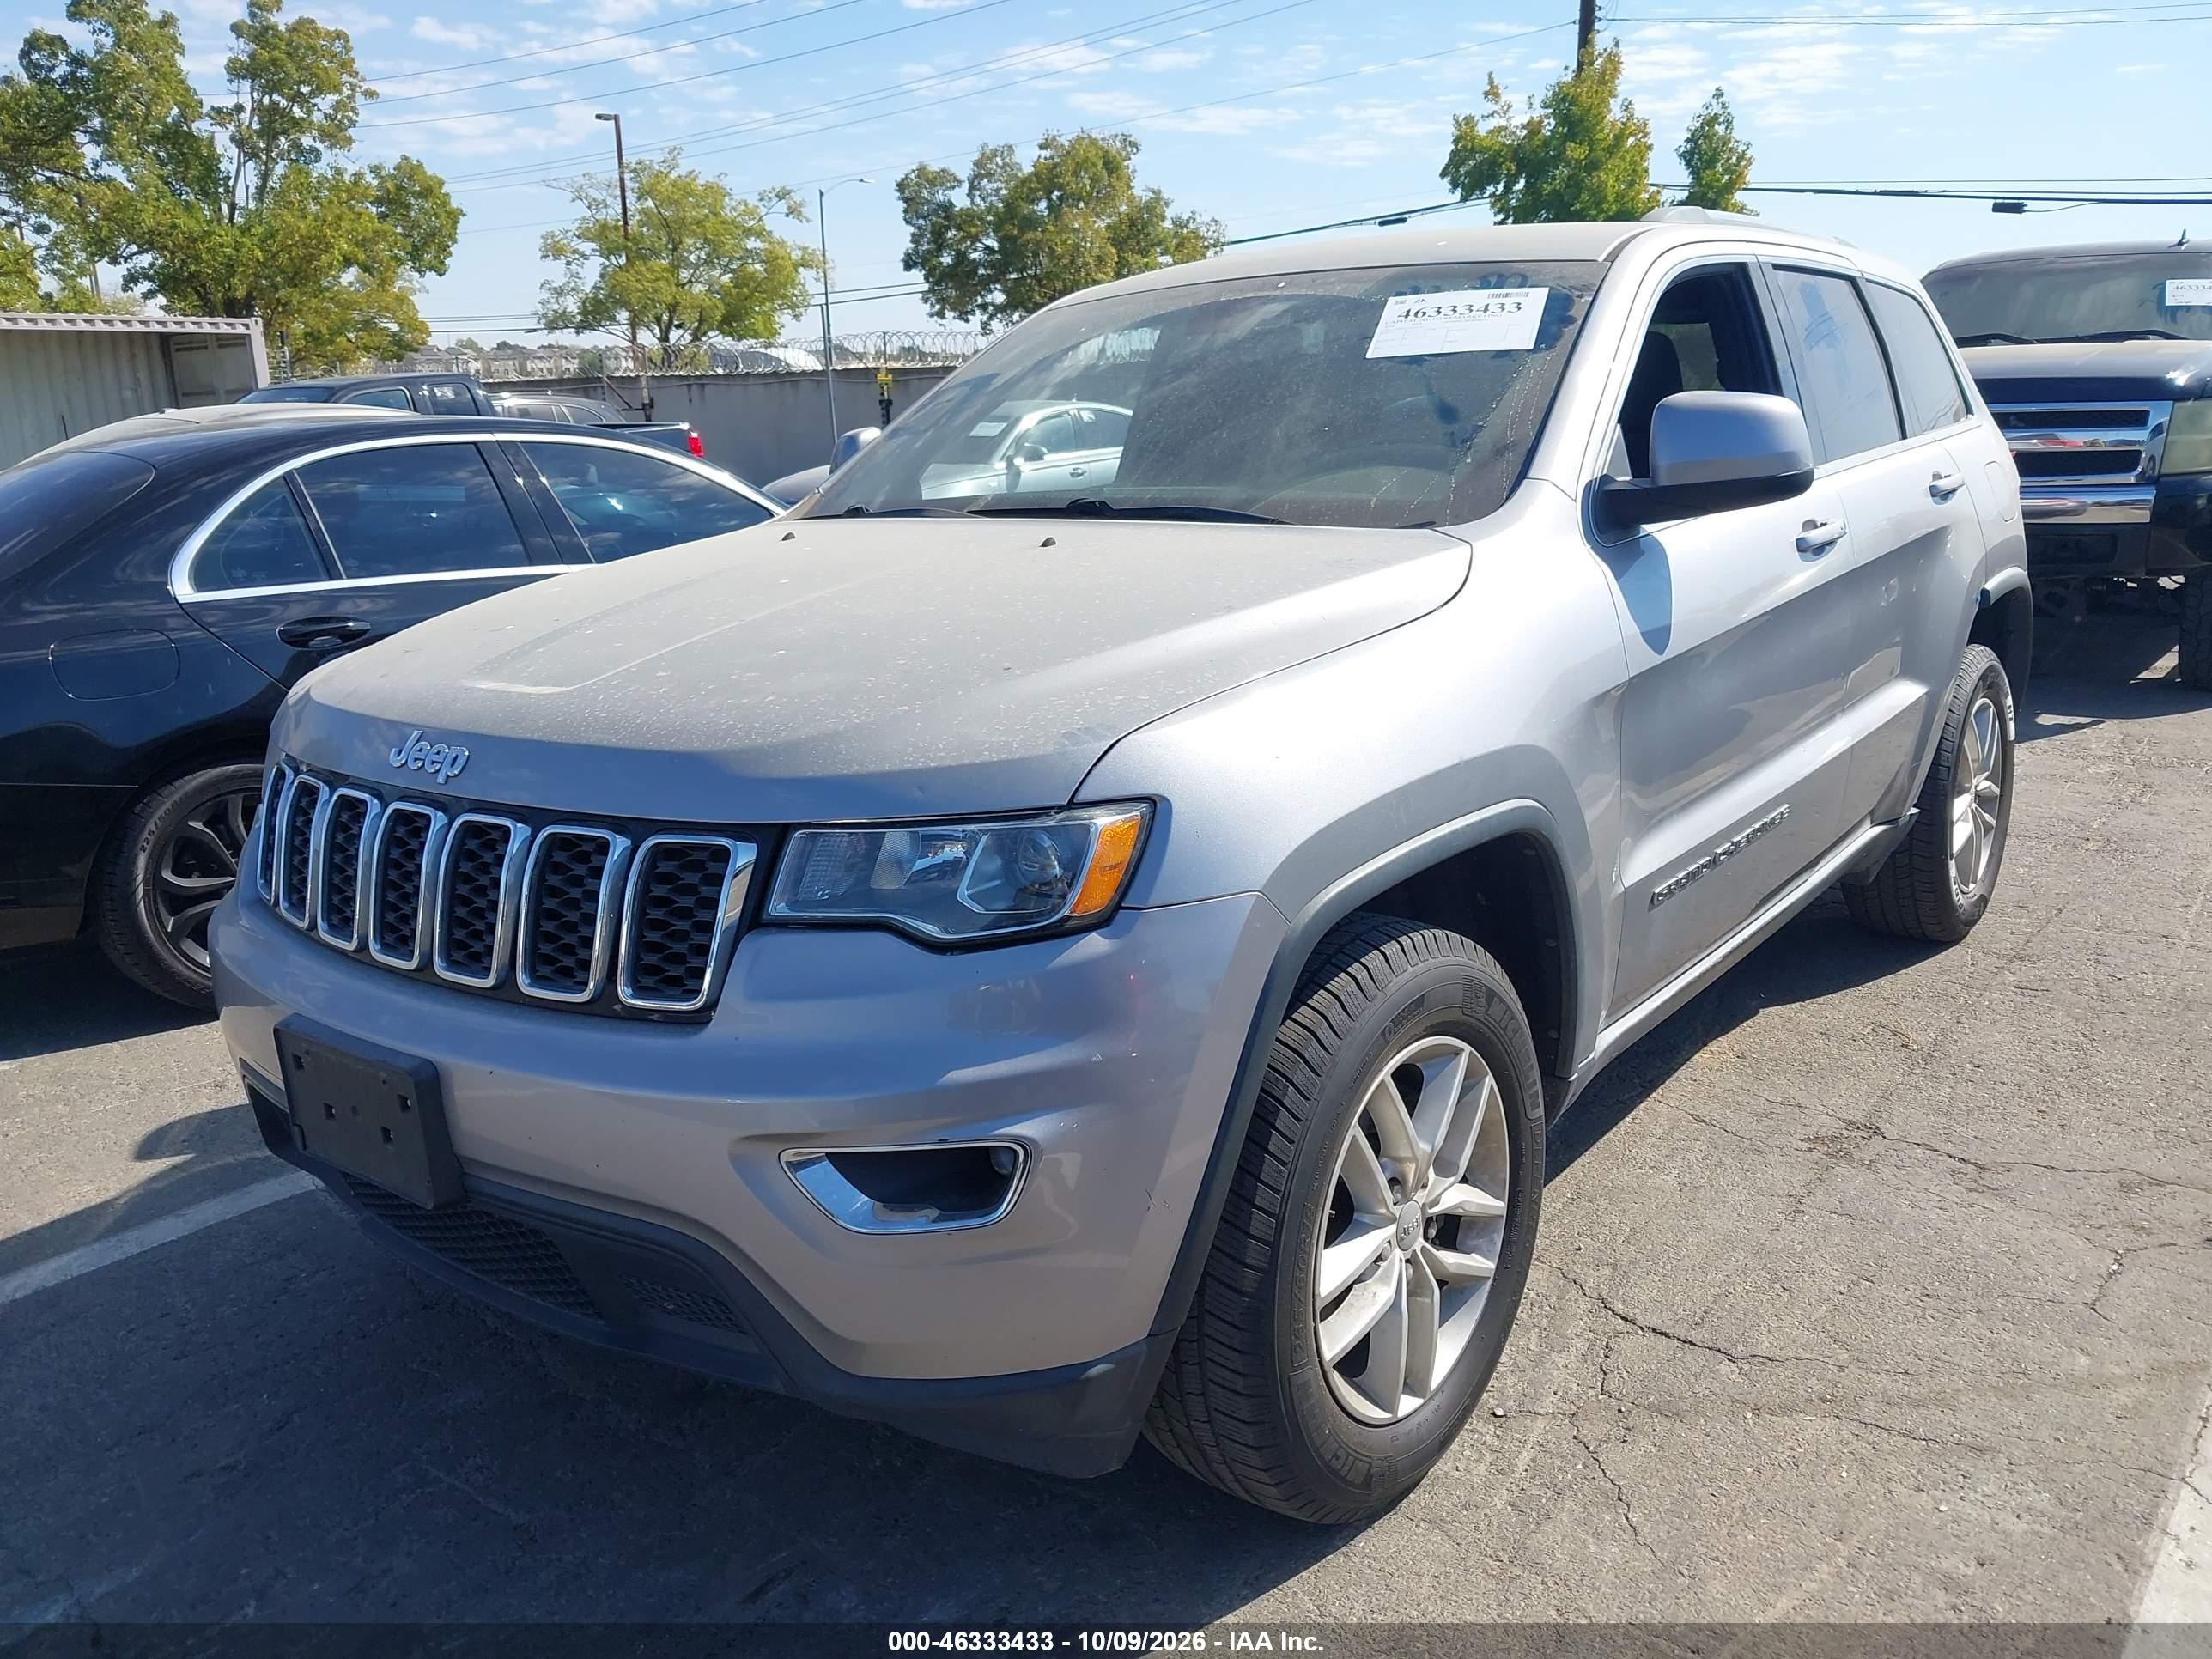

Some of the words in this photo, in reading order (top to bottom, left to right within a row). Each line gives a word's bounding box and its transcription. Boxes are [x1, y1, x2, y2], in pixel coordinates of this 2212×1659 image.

[1397, 301, 1523, 319] 46333433
[389, 730, 470, 785] Jeep
[1650, 856, 1712, 907] GRAND
[1712, 804, 1792, 866] CHEROKEE
[1487, 995, 1541, 1114] MICHELIN
